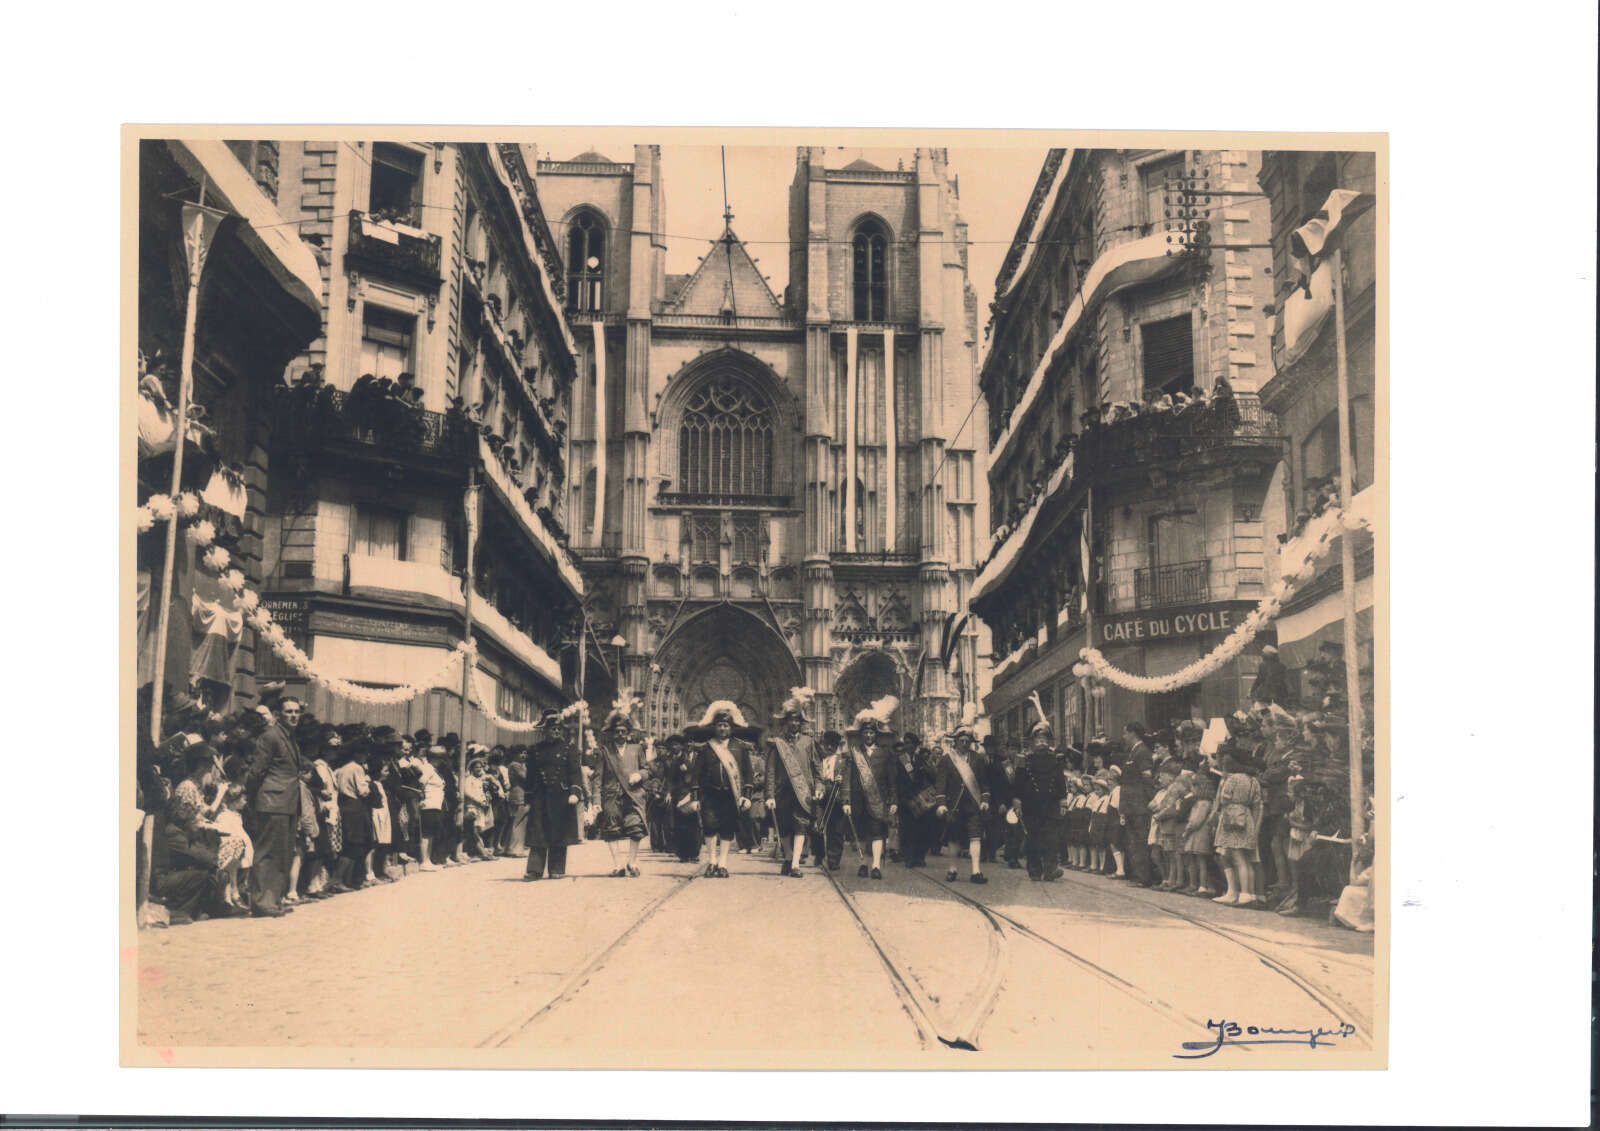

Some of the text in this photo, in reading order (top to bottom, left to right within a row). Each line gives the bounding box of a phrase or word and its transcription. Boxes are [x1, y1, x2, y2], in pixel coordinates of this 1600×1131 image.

[260, 600, 309, 609] ORNEMENS
[1103, 610, 1231, 641] CAFÉ DU CYCLE
